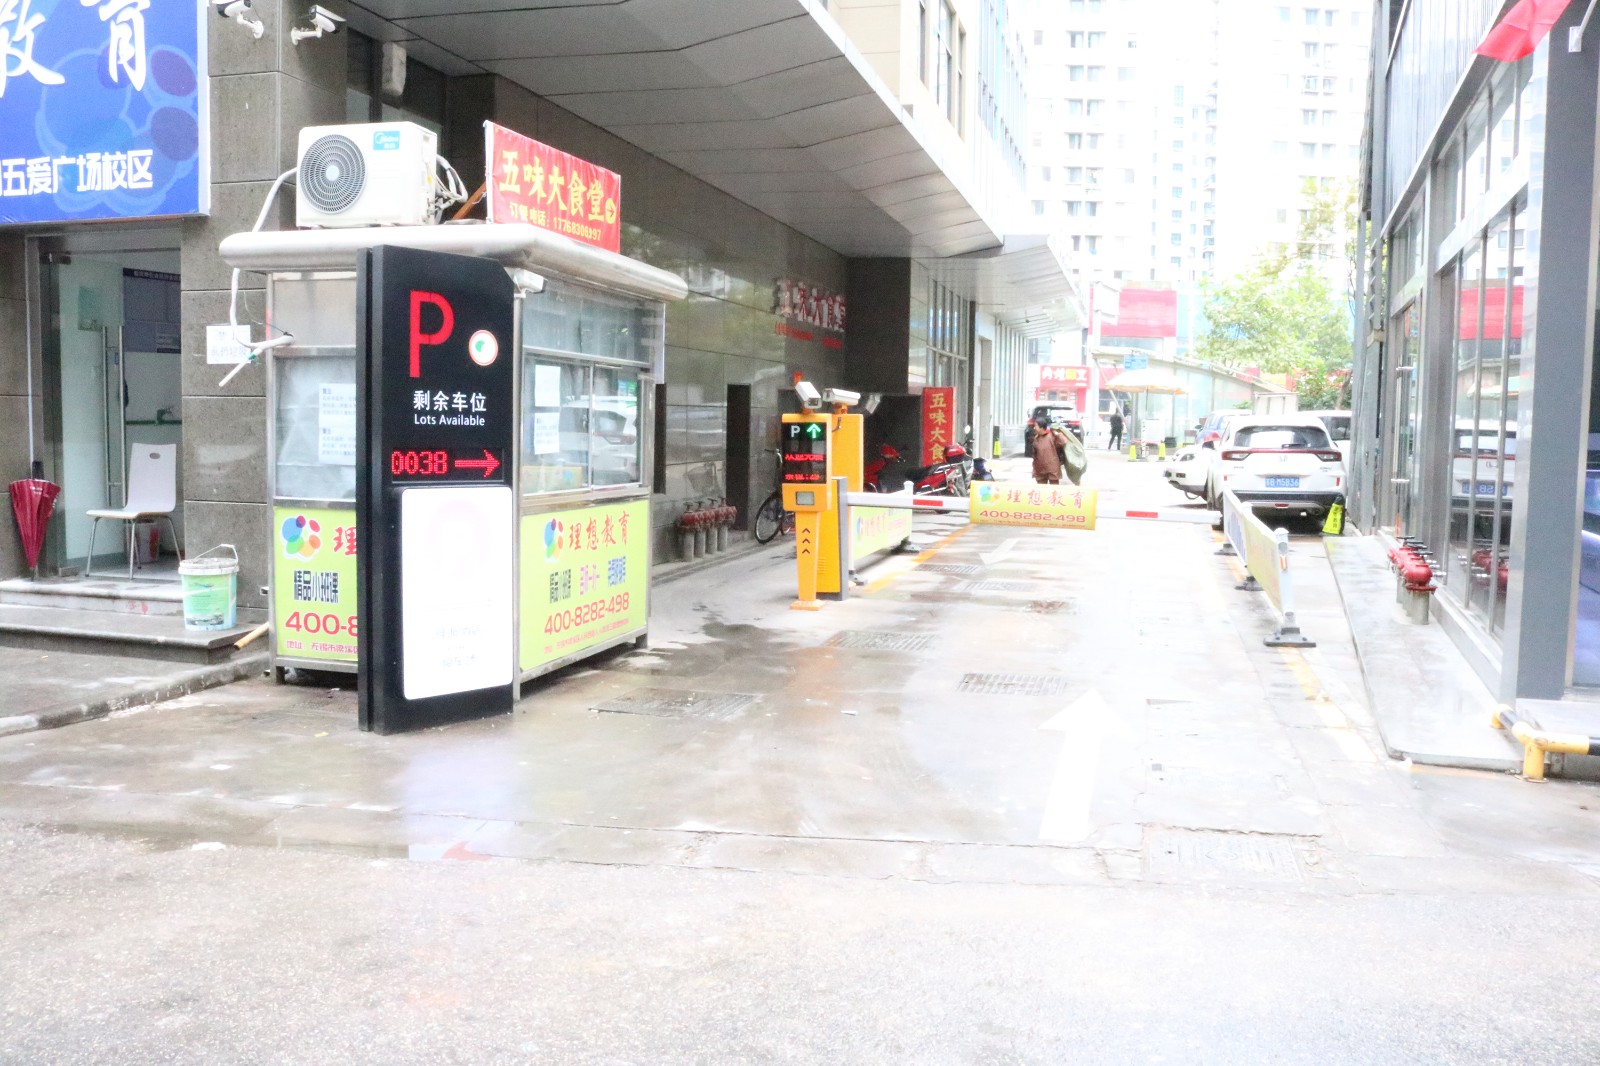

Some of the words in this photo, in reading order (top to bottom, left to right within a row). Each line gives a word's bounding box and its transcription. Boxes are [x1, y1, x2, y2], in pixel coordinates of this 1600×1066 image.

[0, 149, 153, 197] 五爱广场校区
[499, 150, 605, 222] 五味大食堂
[409, 290, 455, 378] P
[413, 390, 487, 412] 剩余车位
[414, 414, 437, 425] Lots
[439, 414, 486, 426] Available
[790, 425, 801, 438] P
[929, 393, 947, 465] 五味大食
[391, 451, 448, 475] 0038
[1006, 489, 1087, 509] 理想教育
[568, 511, 630, 551] 理想教育
[979, 510, 1086, 524] 400-8282-498
[293, 570, 339, 604] 精品小班课
[544, 591, 630, 636] 400-8282-498
